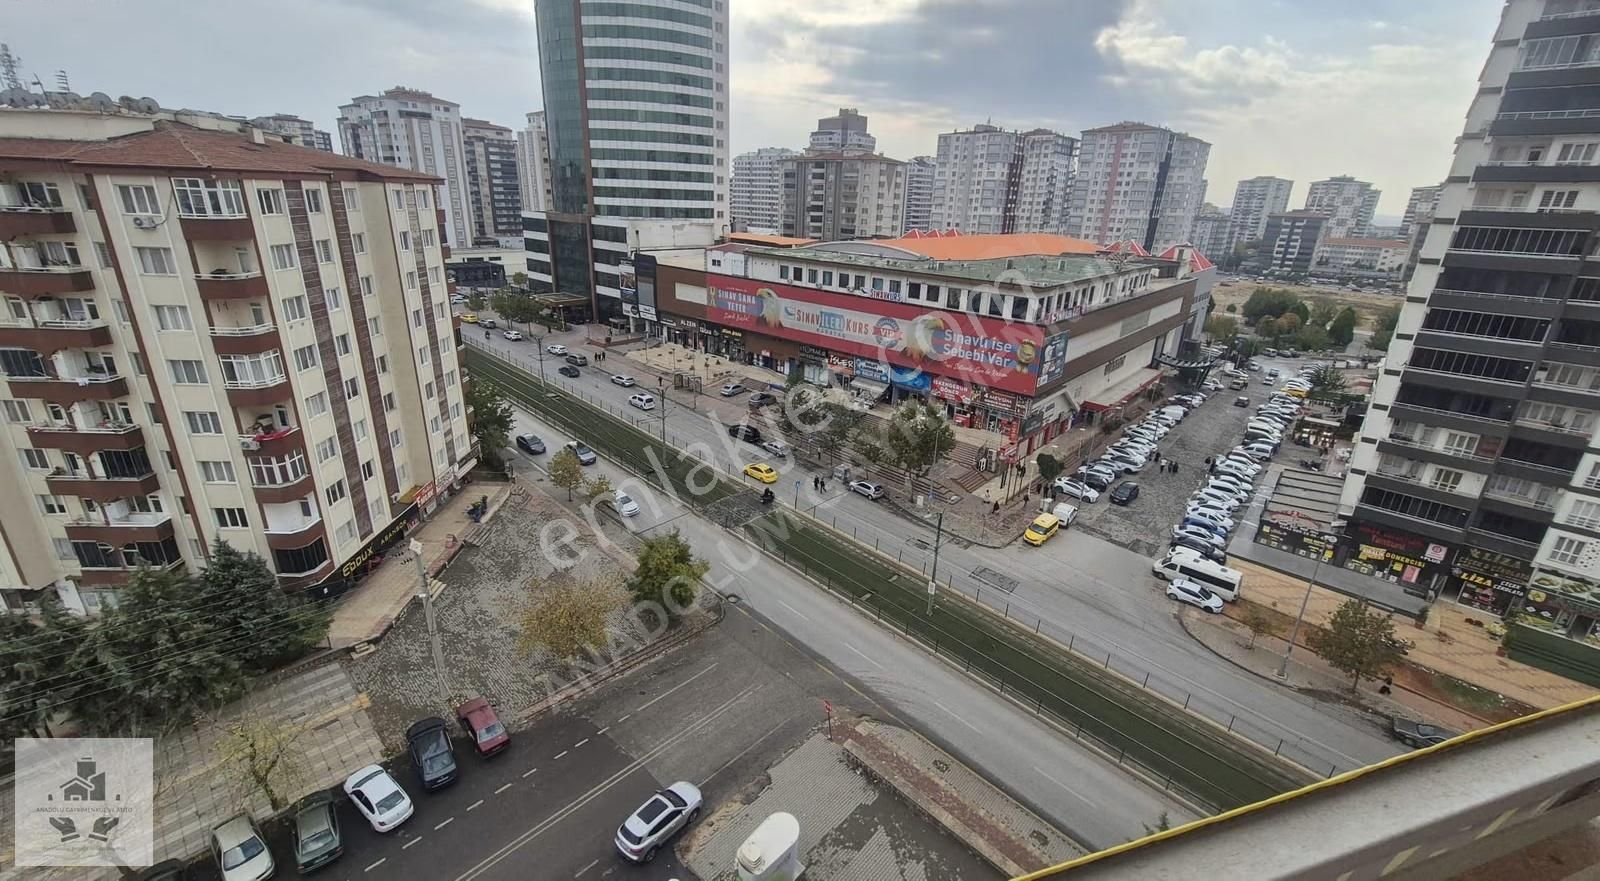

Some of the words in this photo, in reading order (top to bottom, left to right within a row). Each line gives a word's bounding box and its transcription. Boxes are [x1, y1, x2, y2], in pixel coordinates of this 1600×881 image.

[718, 288, 738, 300] SINAV
[739, 293, 756, 305] SANA
[727, 302, 746, 313] YETER
[796, 309, 820, 326] SINAV
[846, 318, 869, 335] KURS
[880, 328, 895, 338] VIP
[944, 329, 989, 348] Sınavlı
[992, 336, 1012, 353] ise
[943, 343, 985, 361] Sebebi
[988, 351, 1011, 368] Var
[1460, 572, 1493, 587] LİZA
